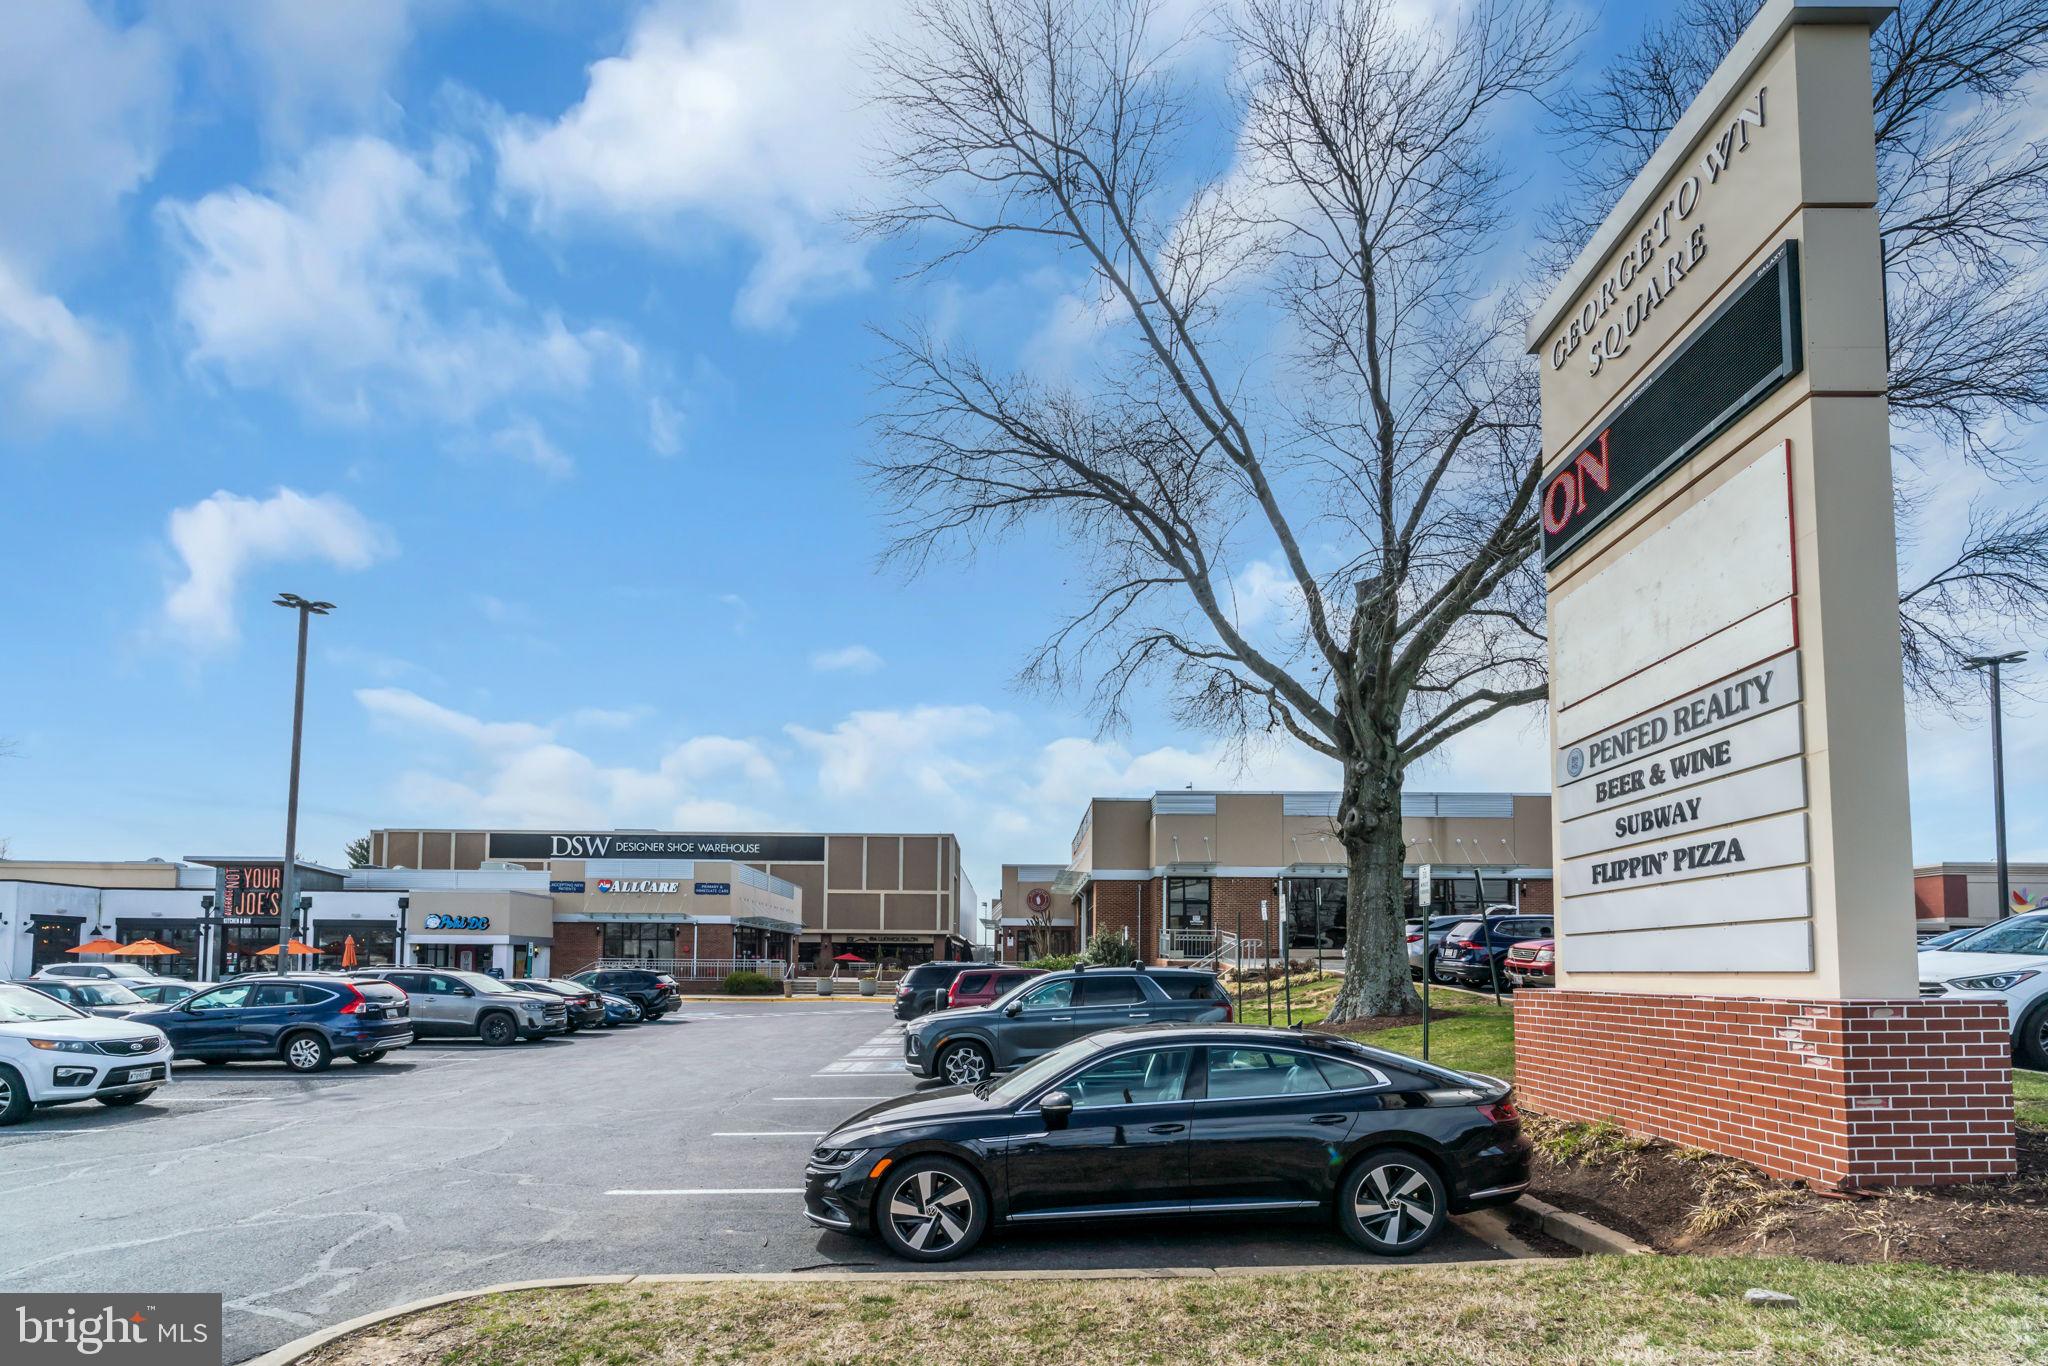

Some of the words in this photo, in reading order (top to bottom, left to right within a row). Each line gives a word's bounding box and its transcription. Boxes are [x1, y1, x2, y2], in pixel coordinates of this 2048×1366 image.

[1551, 85, 1768, 371] GEORGETOWN
[1756, 248, 1785, 277] GALAXY
[1589, 223, 1708, 377] SQUARE
[1543, 427, 1612, 535] ON
[1589, 716, 1668, 769] PENFED
[1673, 670, 1774, 736] REALTY
[1595, 769, 1645, 803] BEER
[1649, 763, 1666, 786] &
[1670, 740, 1732, 779] WINE
[1615, 797, 1702, 838] SUBWAY
[550, 835, 613, 857] DSW
[615, 842, 665, 852] DESIGNER
[667, 842, 695, 852] SHOE
[698, 843, 760, 854] WAREHOUSE
[1591, 850, 1669, 885] FLIPPIN'
[1673, 837, 1745, 872] PIZZA
[225, 864, 240, 888] NOT
[243, 867, 280, 889] YOUR
[235, 892, 280, 916] JOE'S
